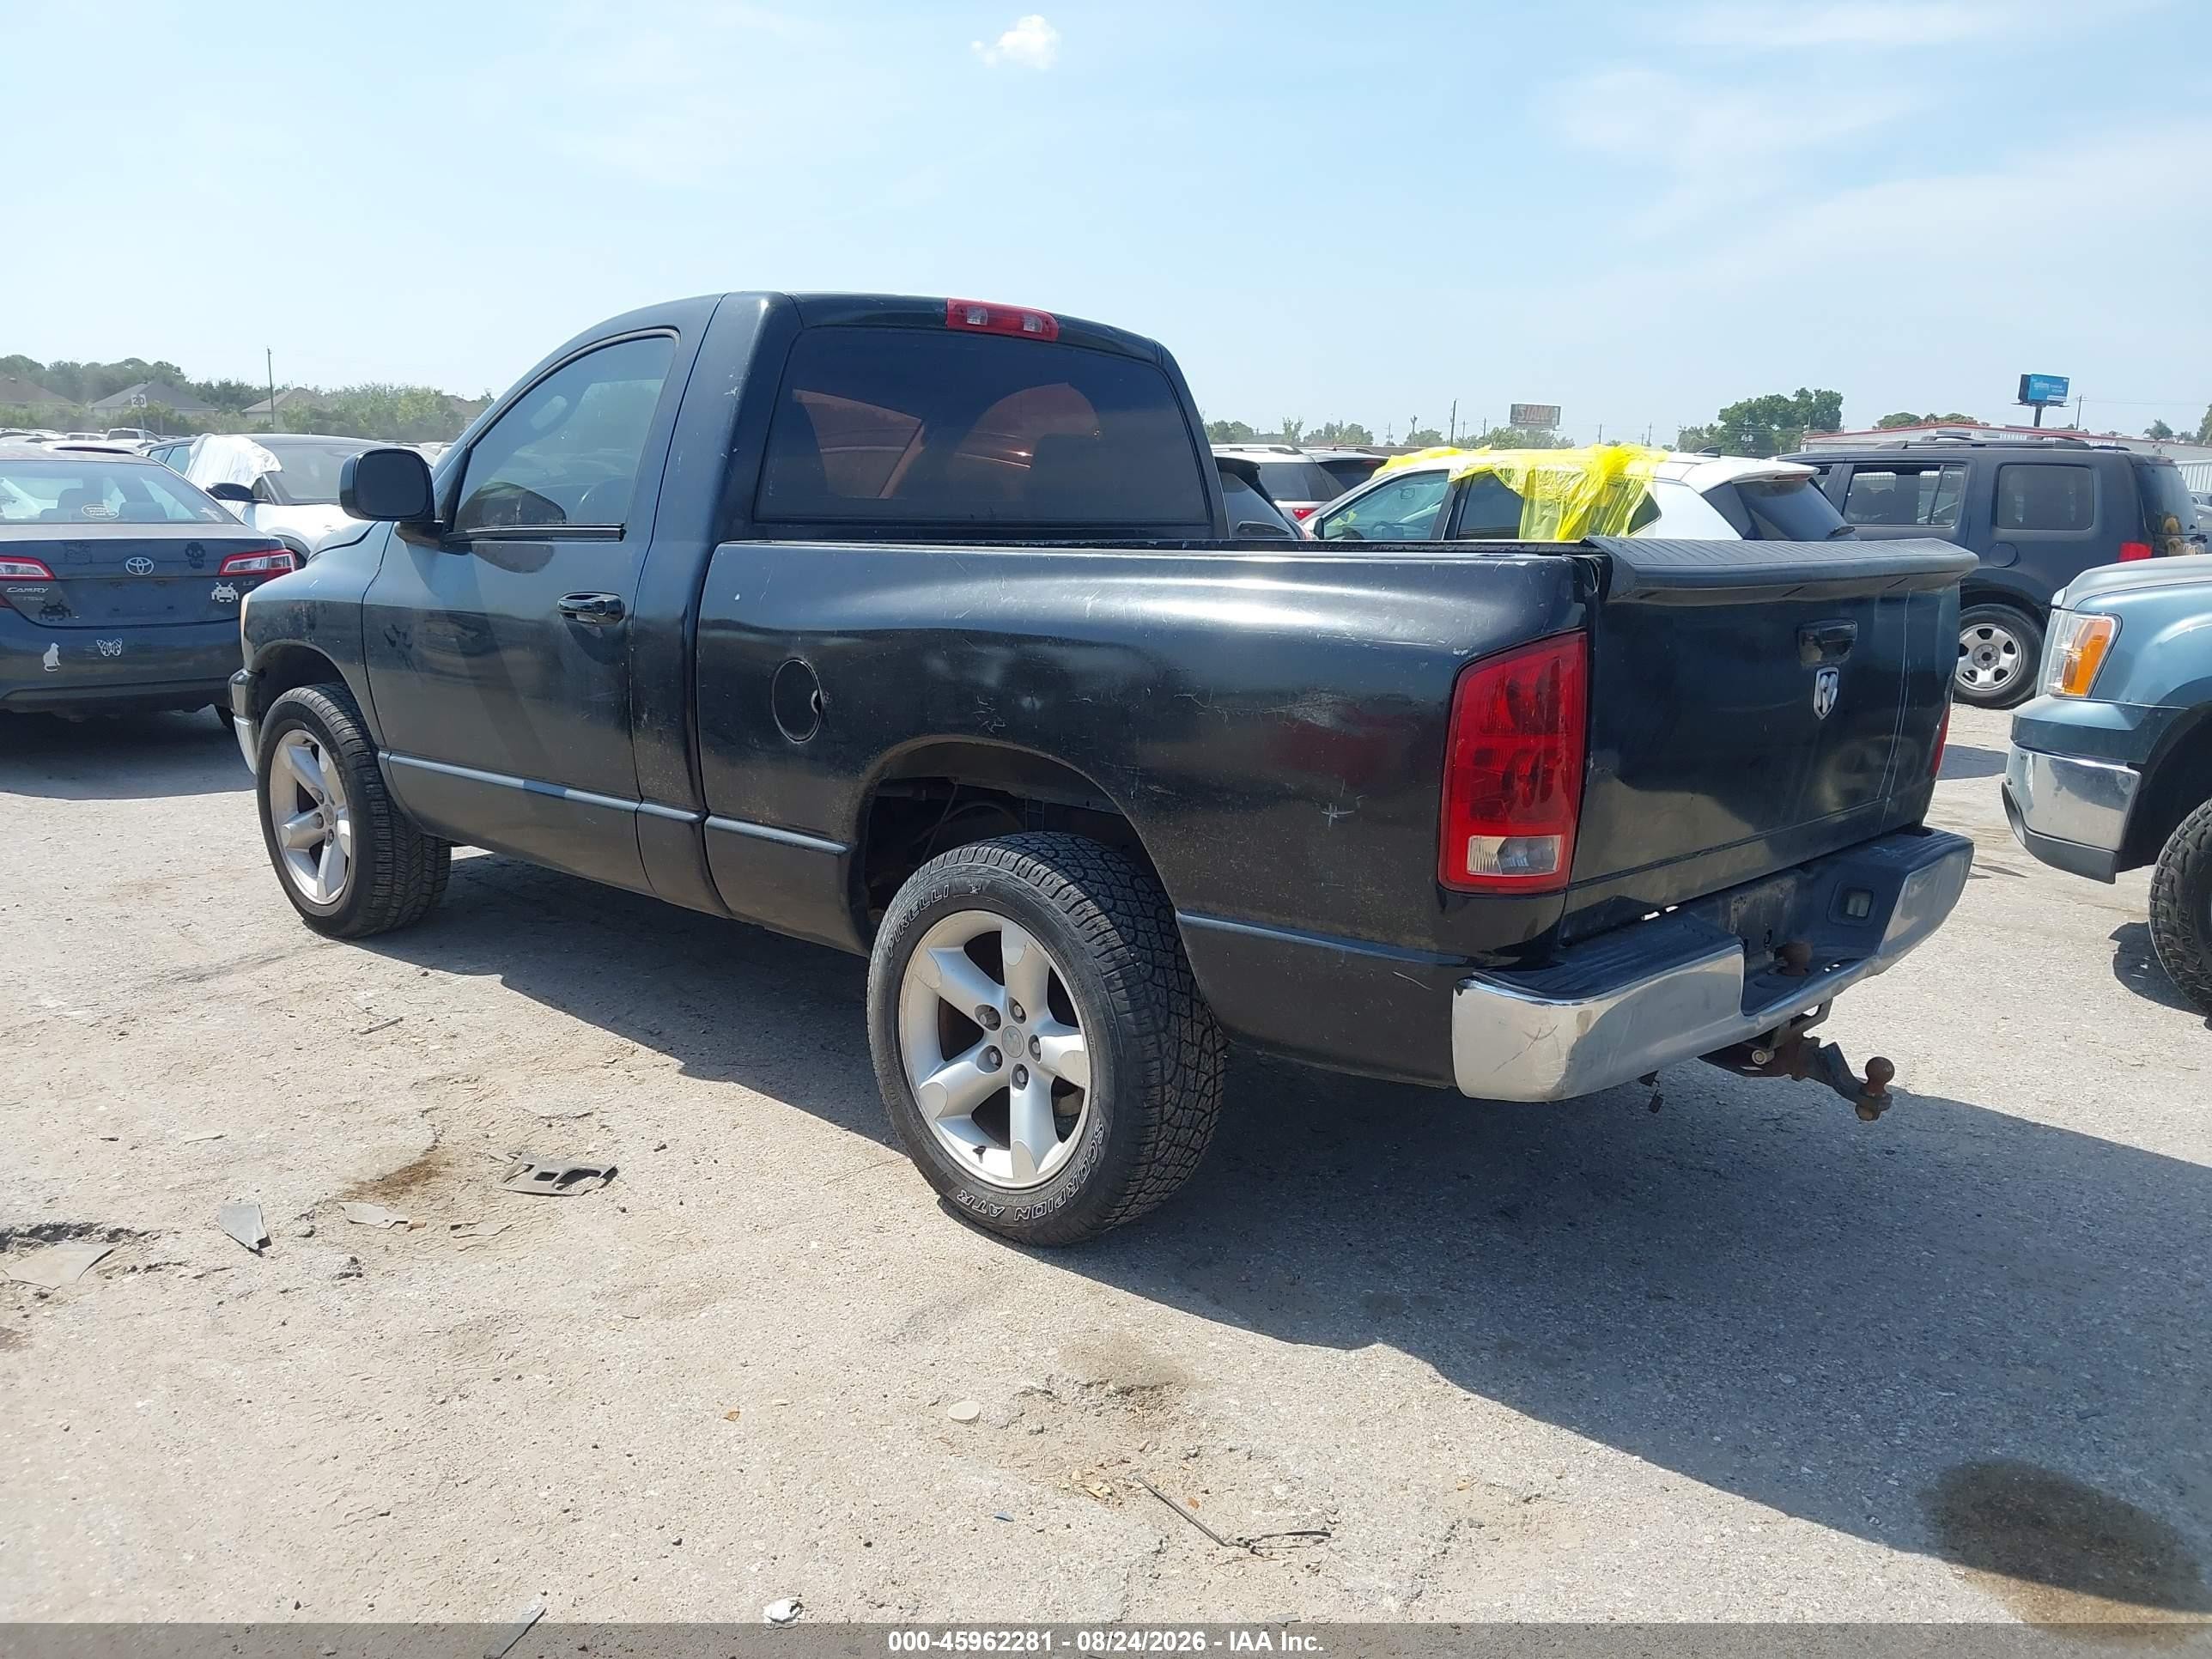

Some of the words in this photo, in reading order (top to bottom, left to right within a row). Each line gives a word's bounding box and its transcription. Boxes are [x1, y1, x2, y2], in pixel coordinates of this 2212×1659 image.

[132, 397, 145, 405] 20
[886, 884, 950, 958] PIRELLI
[1013, 1118, 1105, 1222] SCORPION
[957, 1189, 1005, 1218] ATR
